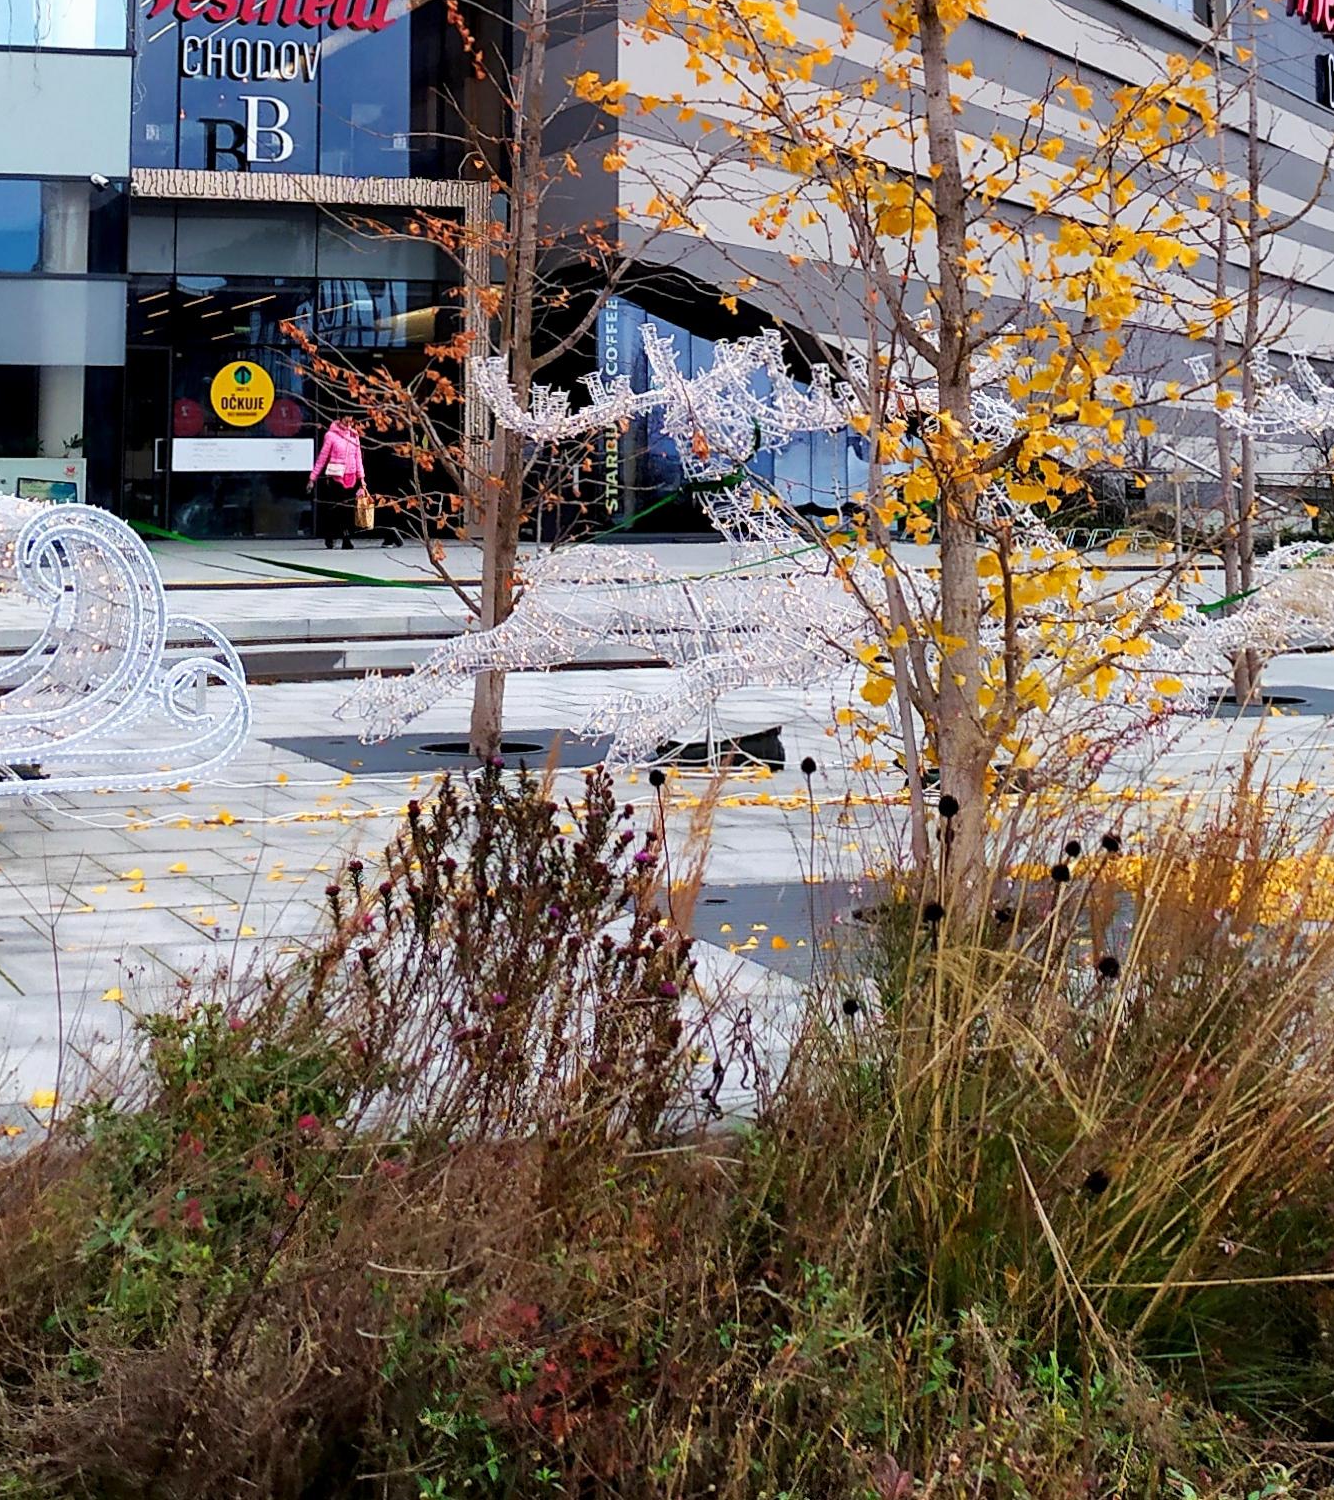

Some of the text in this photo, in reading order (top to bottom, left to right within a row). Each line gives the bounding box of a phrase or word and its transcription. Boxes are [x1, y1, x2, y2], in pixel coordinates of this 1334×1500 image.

[183, 35, 323, 81] CHODOV
[239, 95, 295, 163] B
[221, 393, 264, 410] OČKUJE
[605, 299, 618, 512] STARBUS COFFEE
